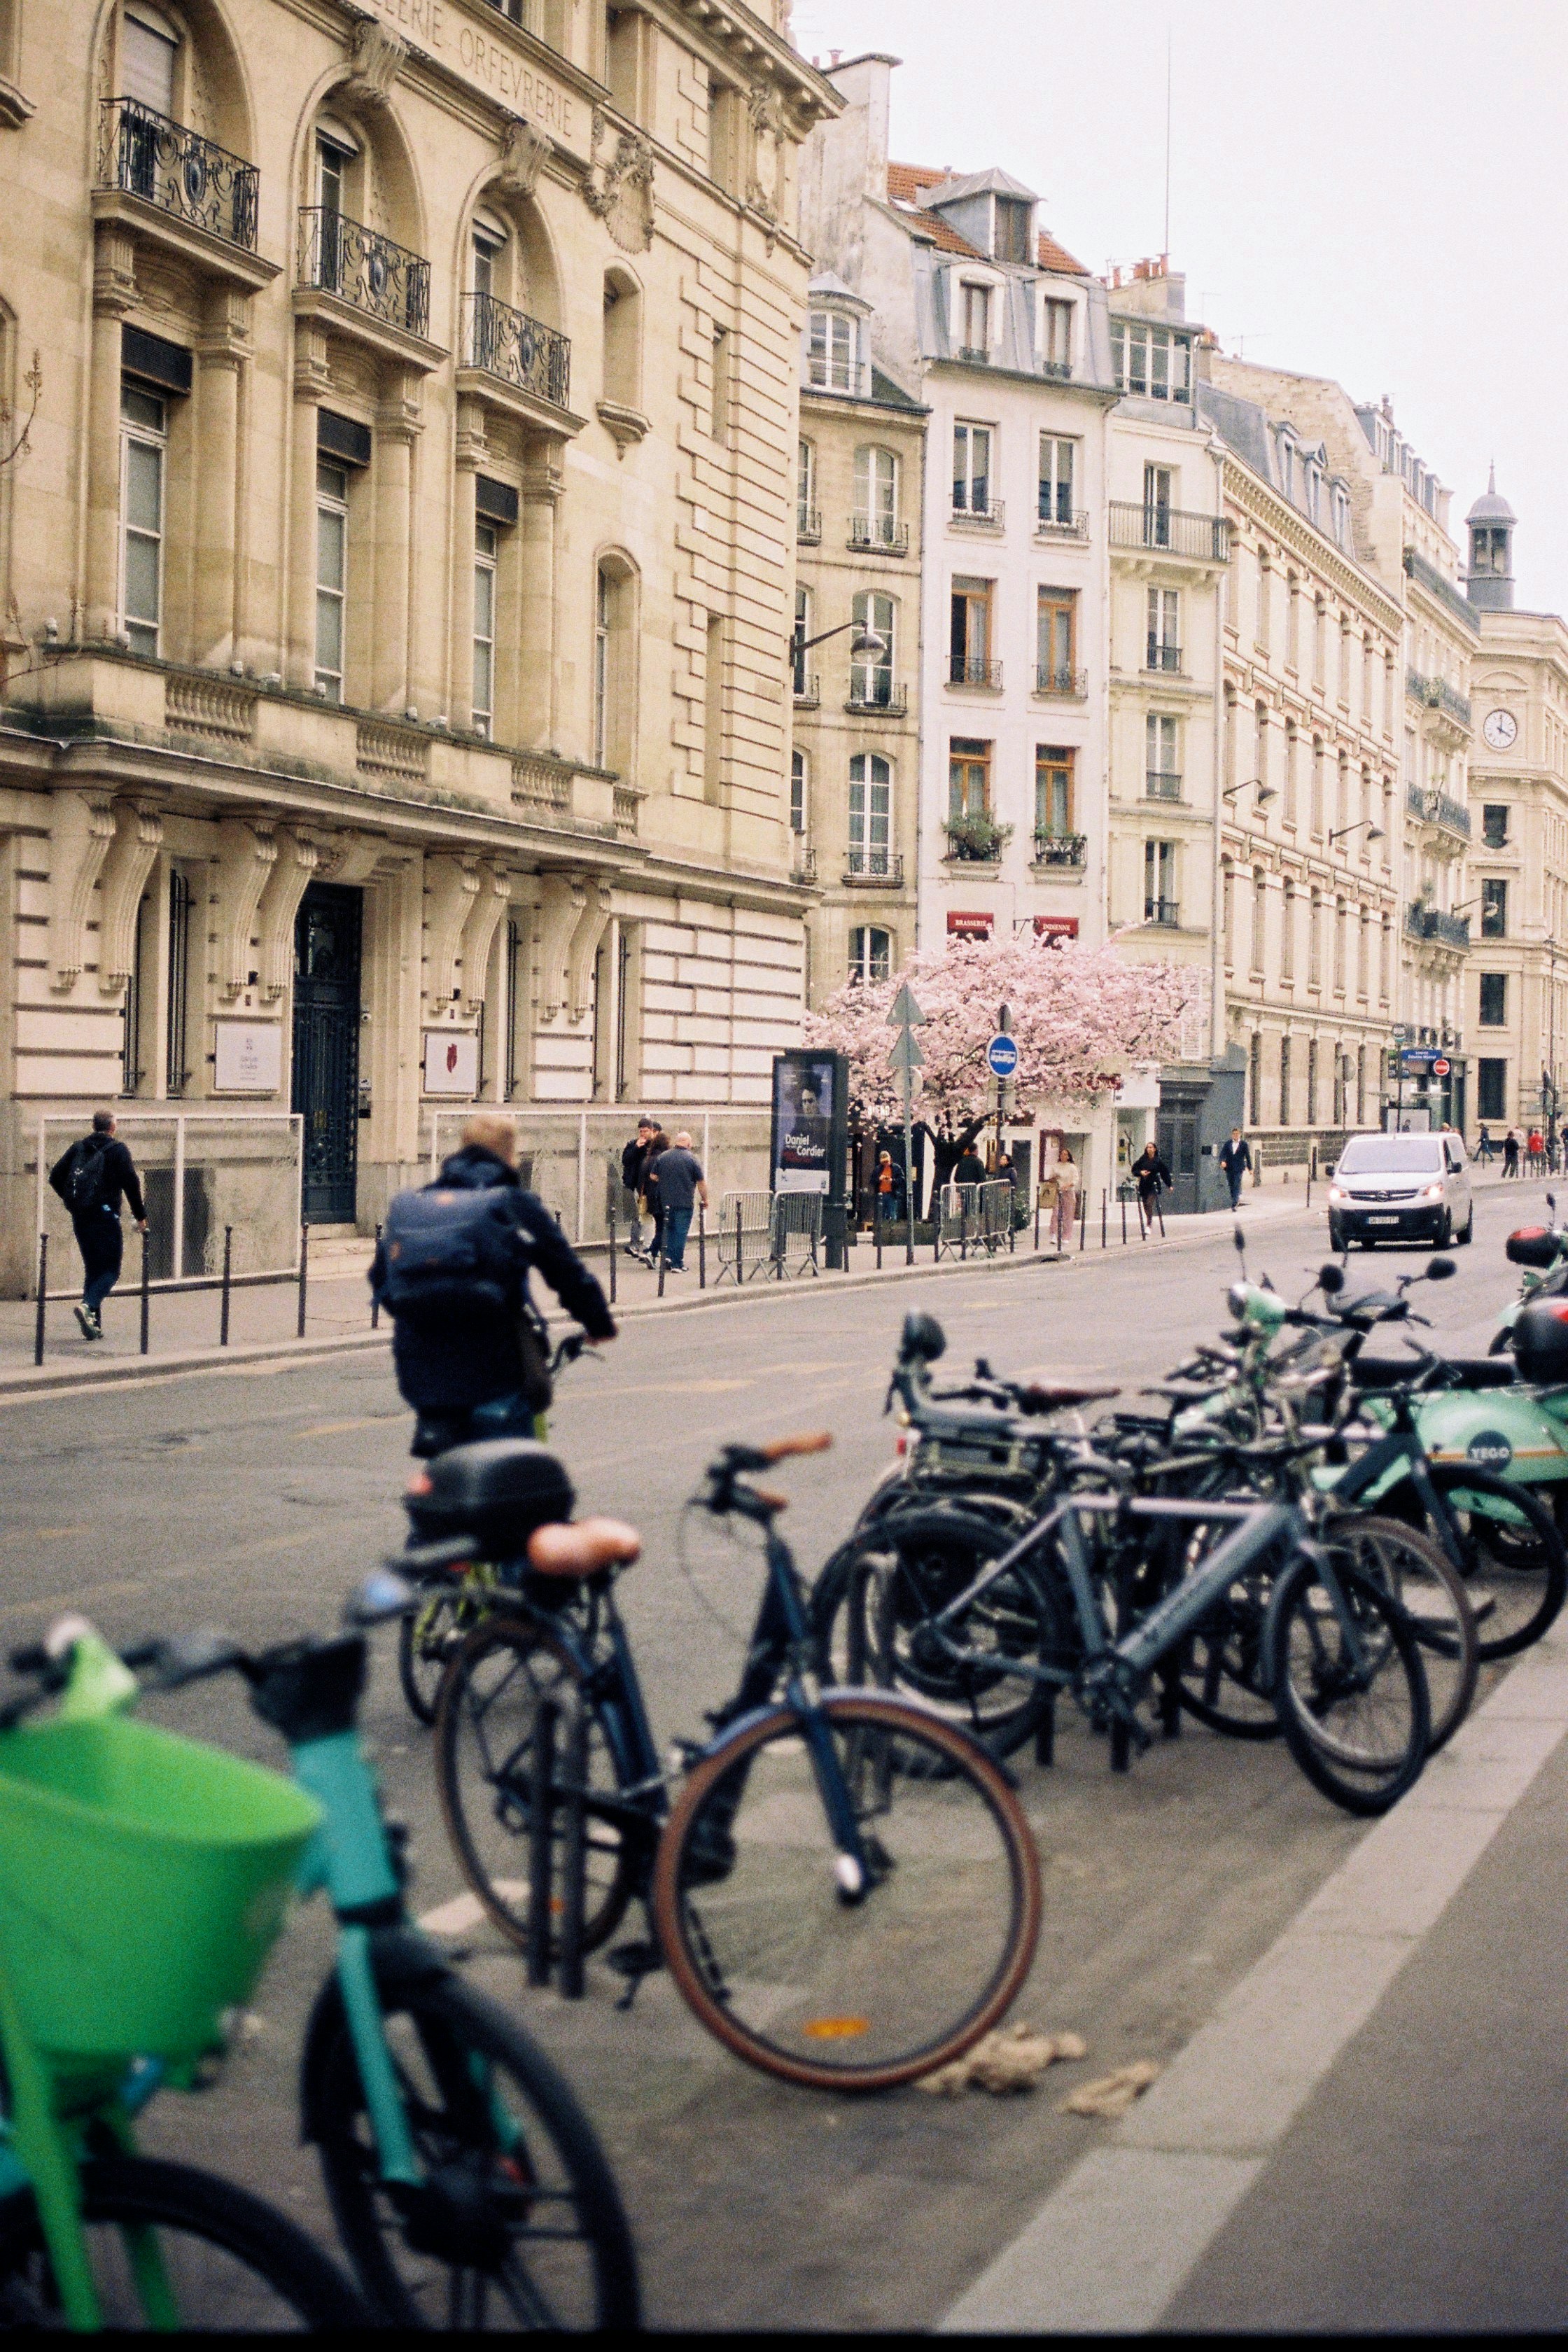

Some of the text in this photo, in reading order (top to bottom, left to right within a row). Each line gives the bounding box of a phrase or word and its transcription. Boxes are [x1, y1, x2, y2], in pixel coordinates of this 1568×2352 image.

[459, 28, 572, 137] ORFEVRERIE
[785, 1133, 809, 1144] Daniel
[797, 1144, 825, 1157] Cordier
[1471, 1447, 1509, 1459] YEGO
